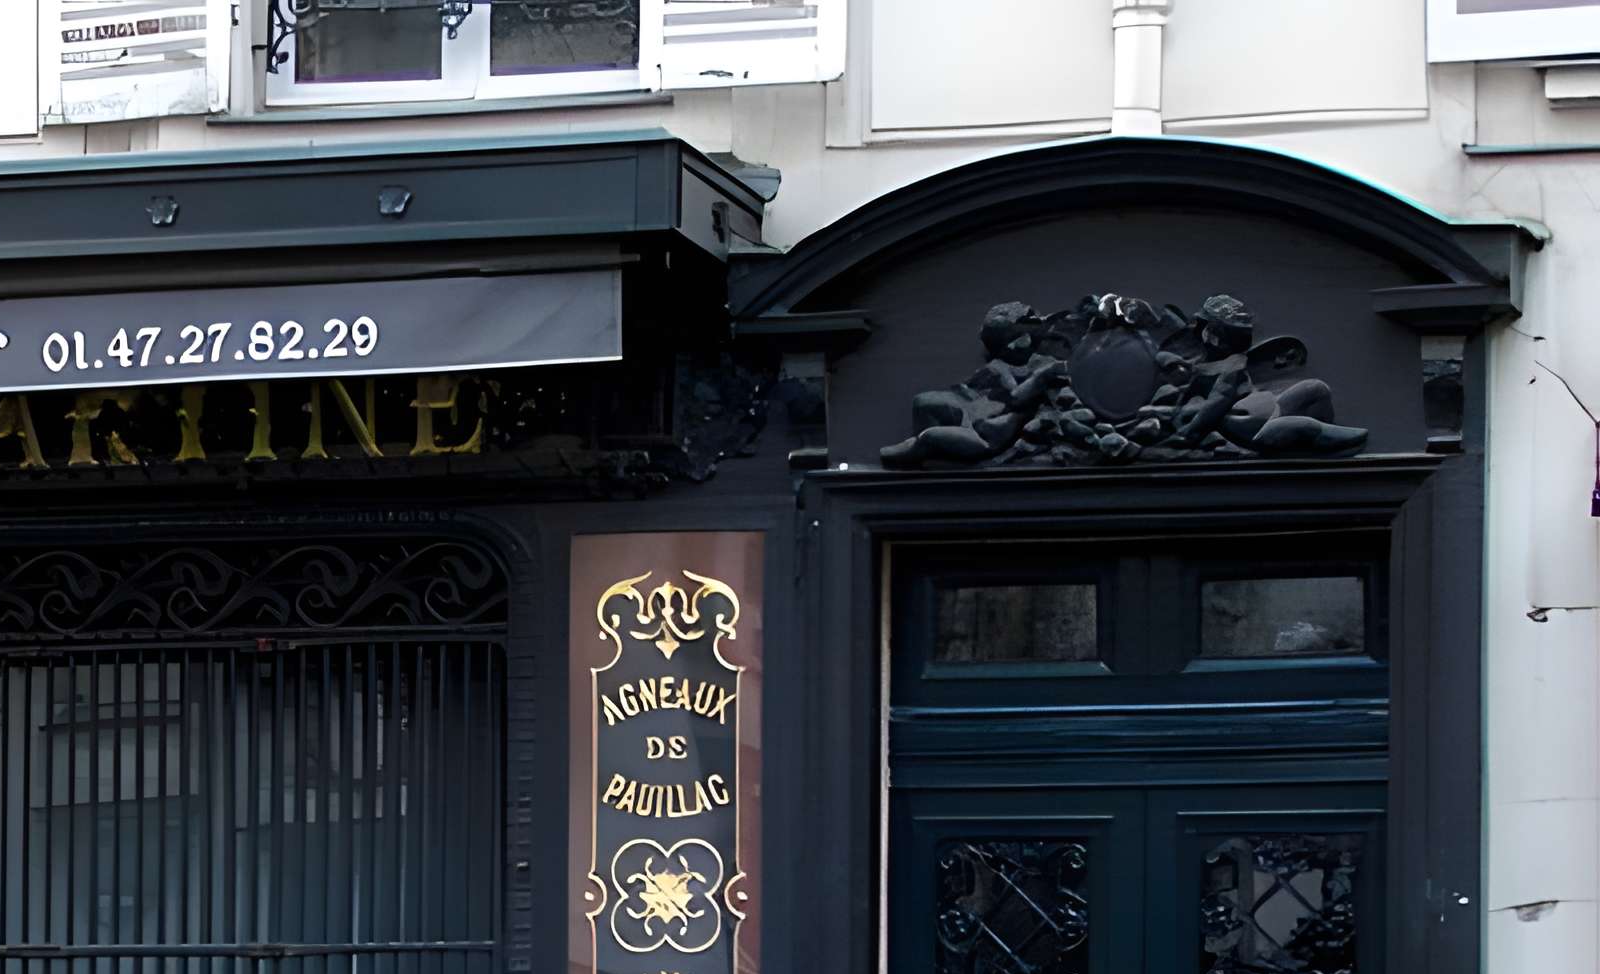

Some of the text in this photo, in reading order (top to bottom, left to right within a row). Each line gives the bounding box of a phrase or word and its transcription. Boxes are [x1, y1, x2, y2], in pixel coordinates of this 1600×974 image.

[42, 316, 378, 372] 01.47.27.82.29
[601, 676, 736, 725] AGNEAUX
[602, 773, 730, 818] PAUILLAC
